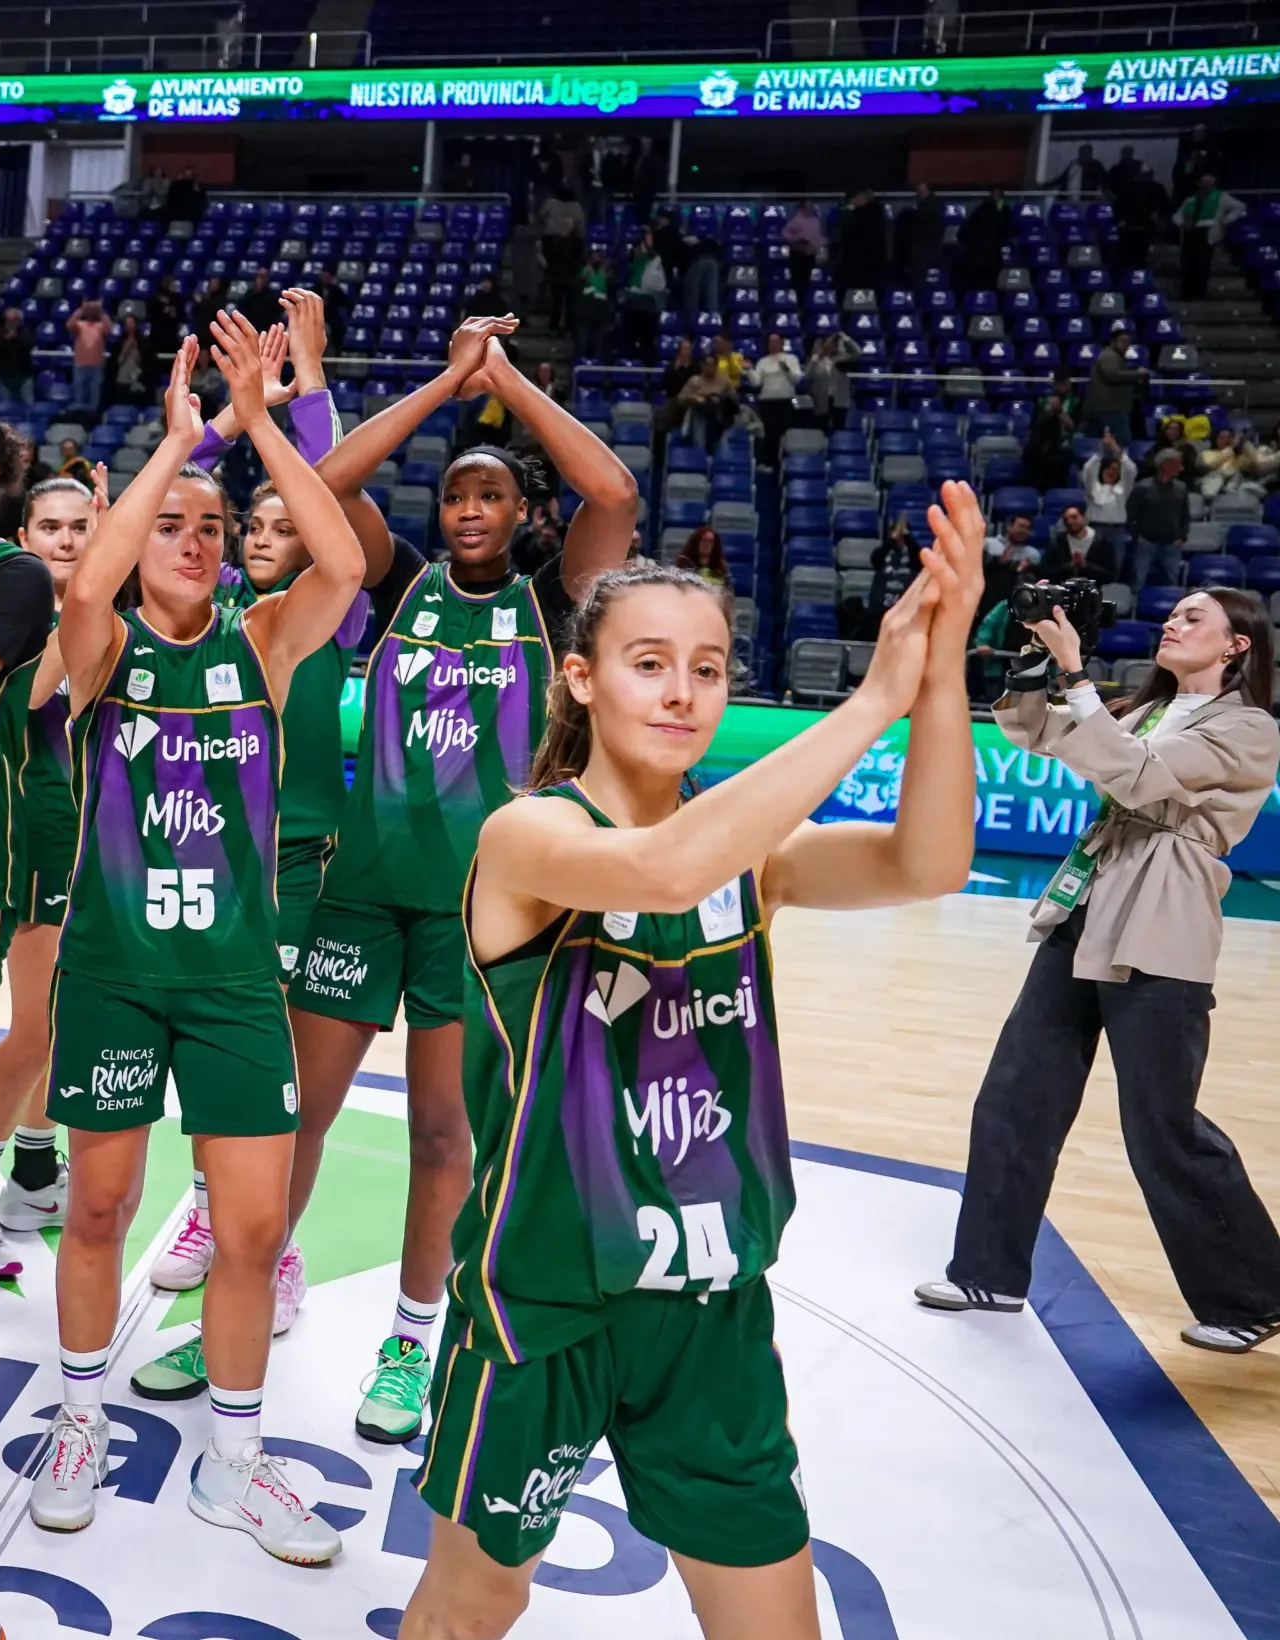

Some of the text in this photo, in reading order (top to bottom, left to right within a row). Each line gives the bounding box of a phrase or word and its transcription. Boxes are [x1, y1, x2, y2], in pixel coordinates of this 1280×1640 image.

[149, 76, 303, 97] AYUNTAMIENTO
[754, 66, 939, 89] AYUNTAMIENTO
[350, 72, 638, 113] NUESTRA PROVINCIA Juega
[753, 90, 861, 110] DE MIJAS
[1103, 79, 1229, 104] DE MIJAS
[148, 97, 240, 116] DE MIJAS
[433, 662, 516, 688] Unicaja
[406, 708, 480, 758] Mijas
[162, 730, 260, 765] Unicaja
[142, 789, 225, 845] Mijas
[146, 868, 215, 930] 55
[316, 937, 361, 956] CLINICAS
[305, 980, 352, 1000] DENTAL
[101, 1048, 154, 1061] CLINICAS
[96, 1096, 144, 1111] DENTAL
[623, 1076, 733, 1166] Mijas
[636, 1201, 739, 1300] 24
